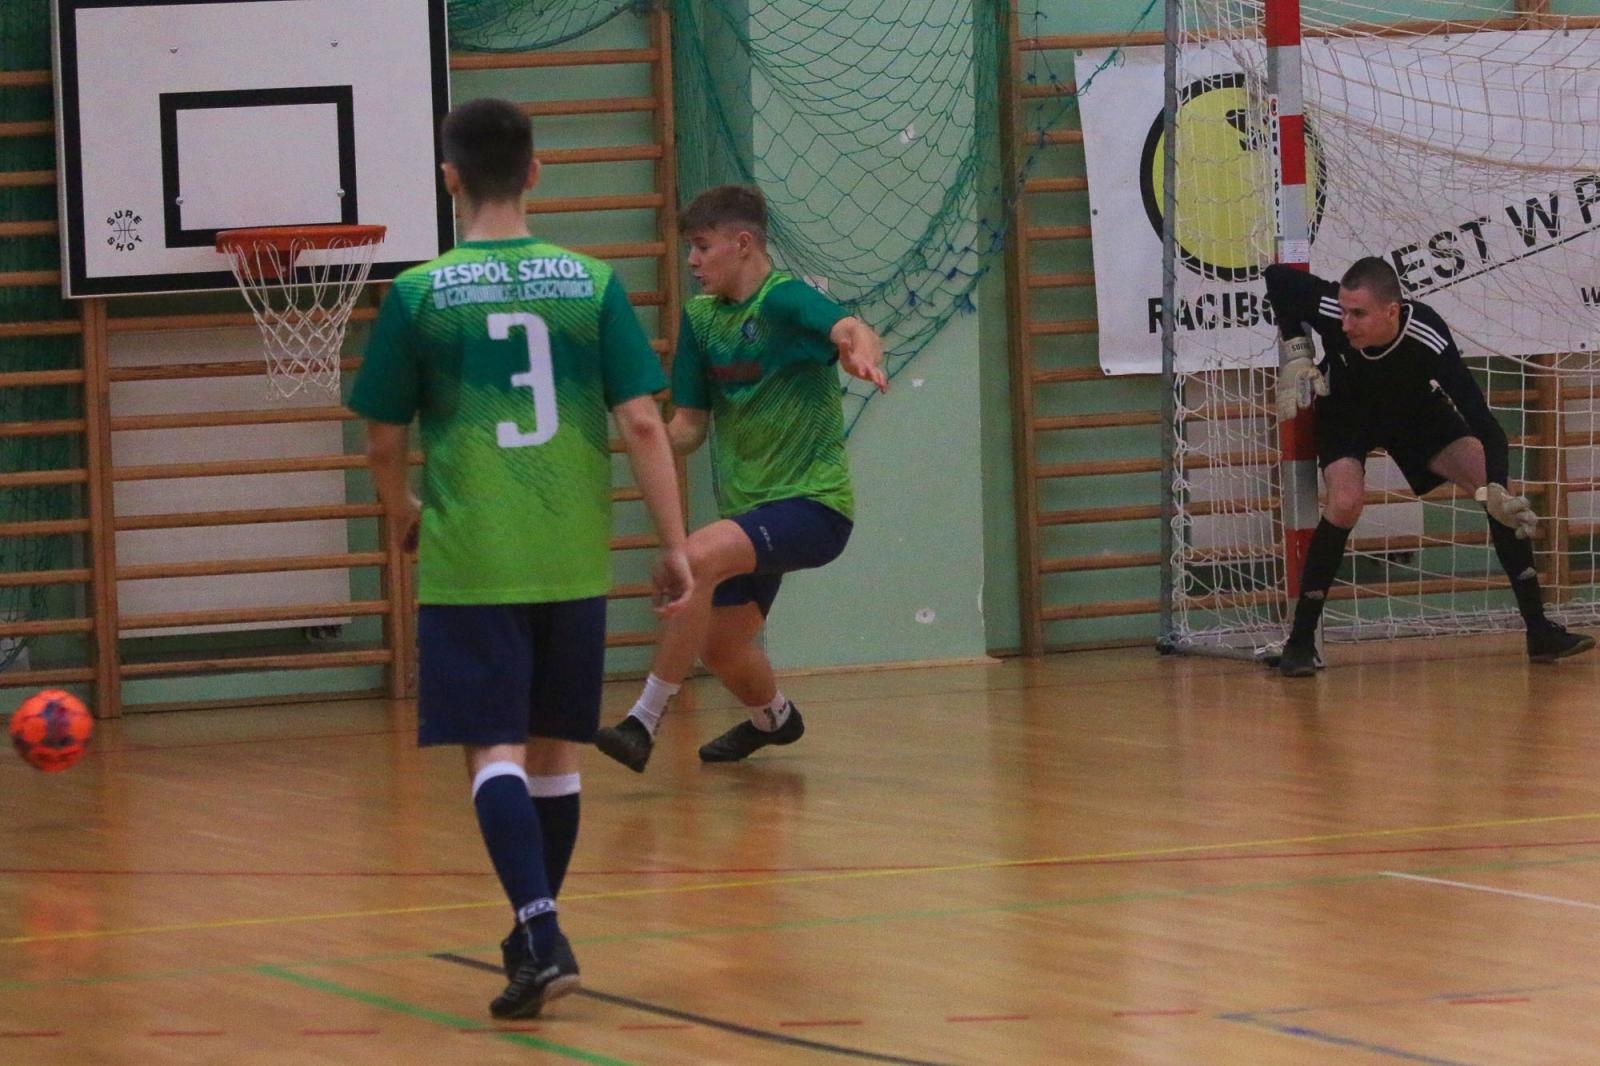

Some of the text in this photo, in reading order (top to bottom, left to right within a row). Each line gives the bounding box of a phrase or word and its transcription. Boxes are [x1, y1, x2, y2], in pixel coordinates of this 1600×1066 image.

[106, 209, 142, 226] SURE
[106, 235, 143, 252] SHOT
[1391, 214, 1492, 294] EST
[1505, 190, 1561, 248] W
[430, 254, 589, 290] ZESPÓŁ SZKÓŁ
[486, 312, 559, 448] 3
